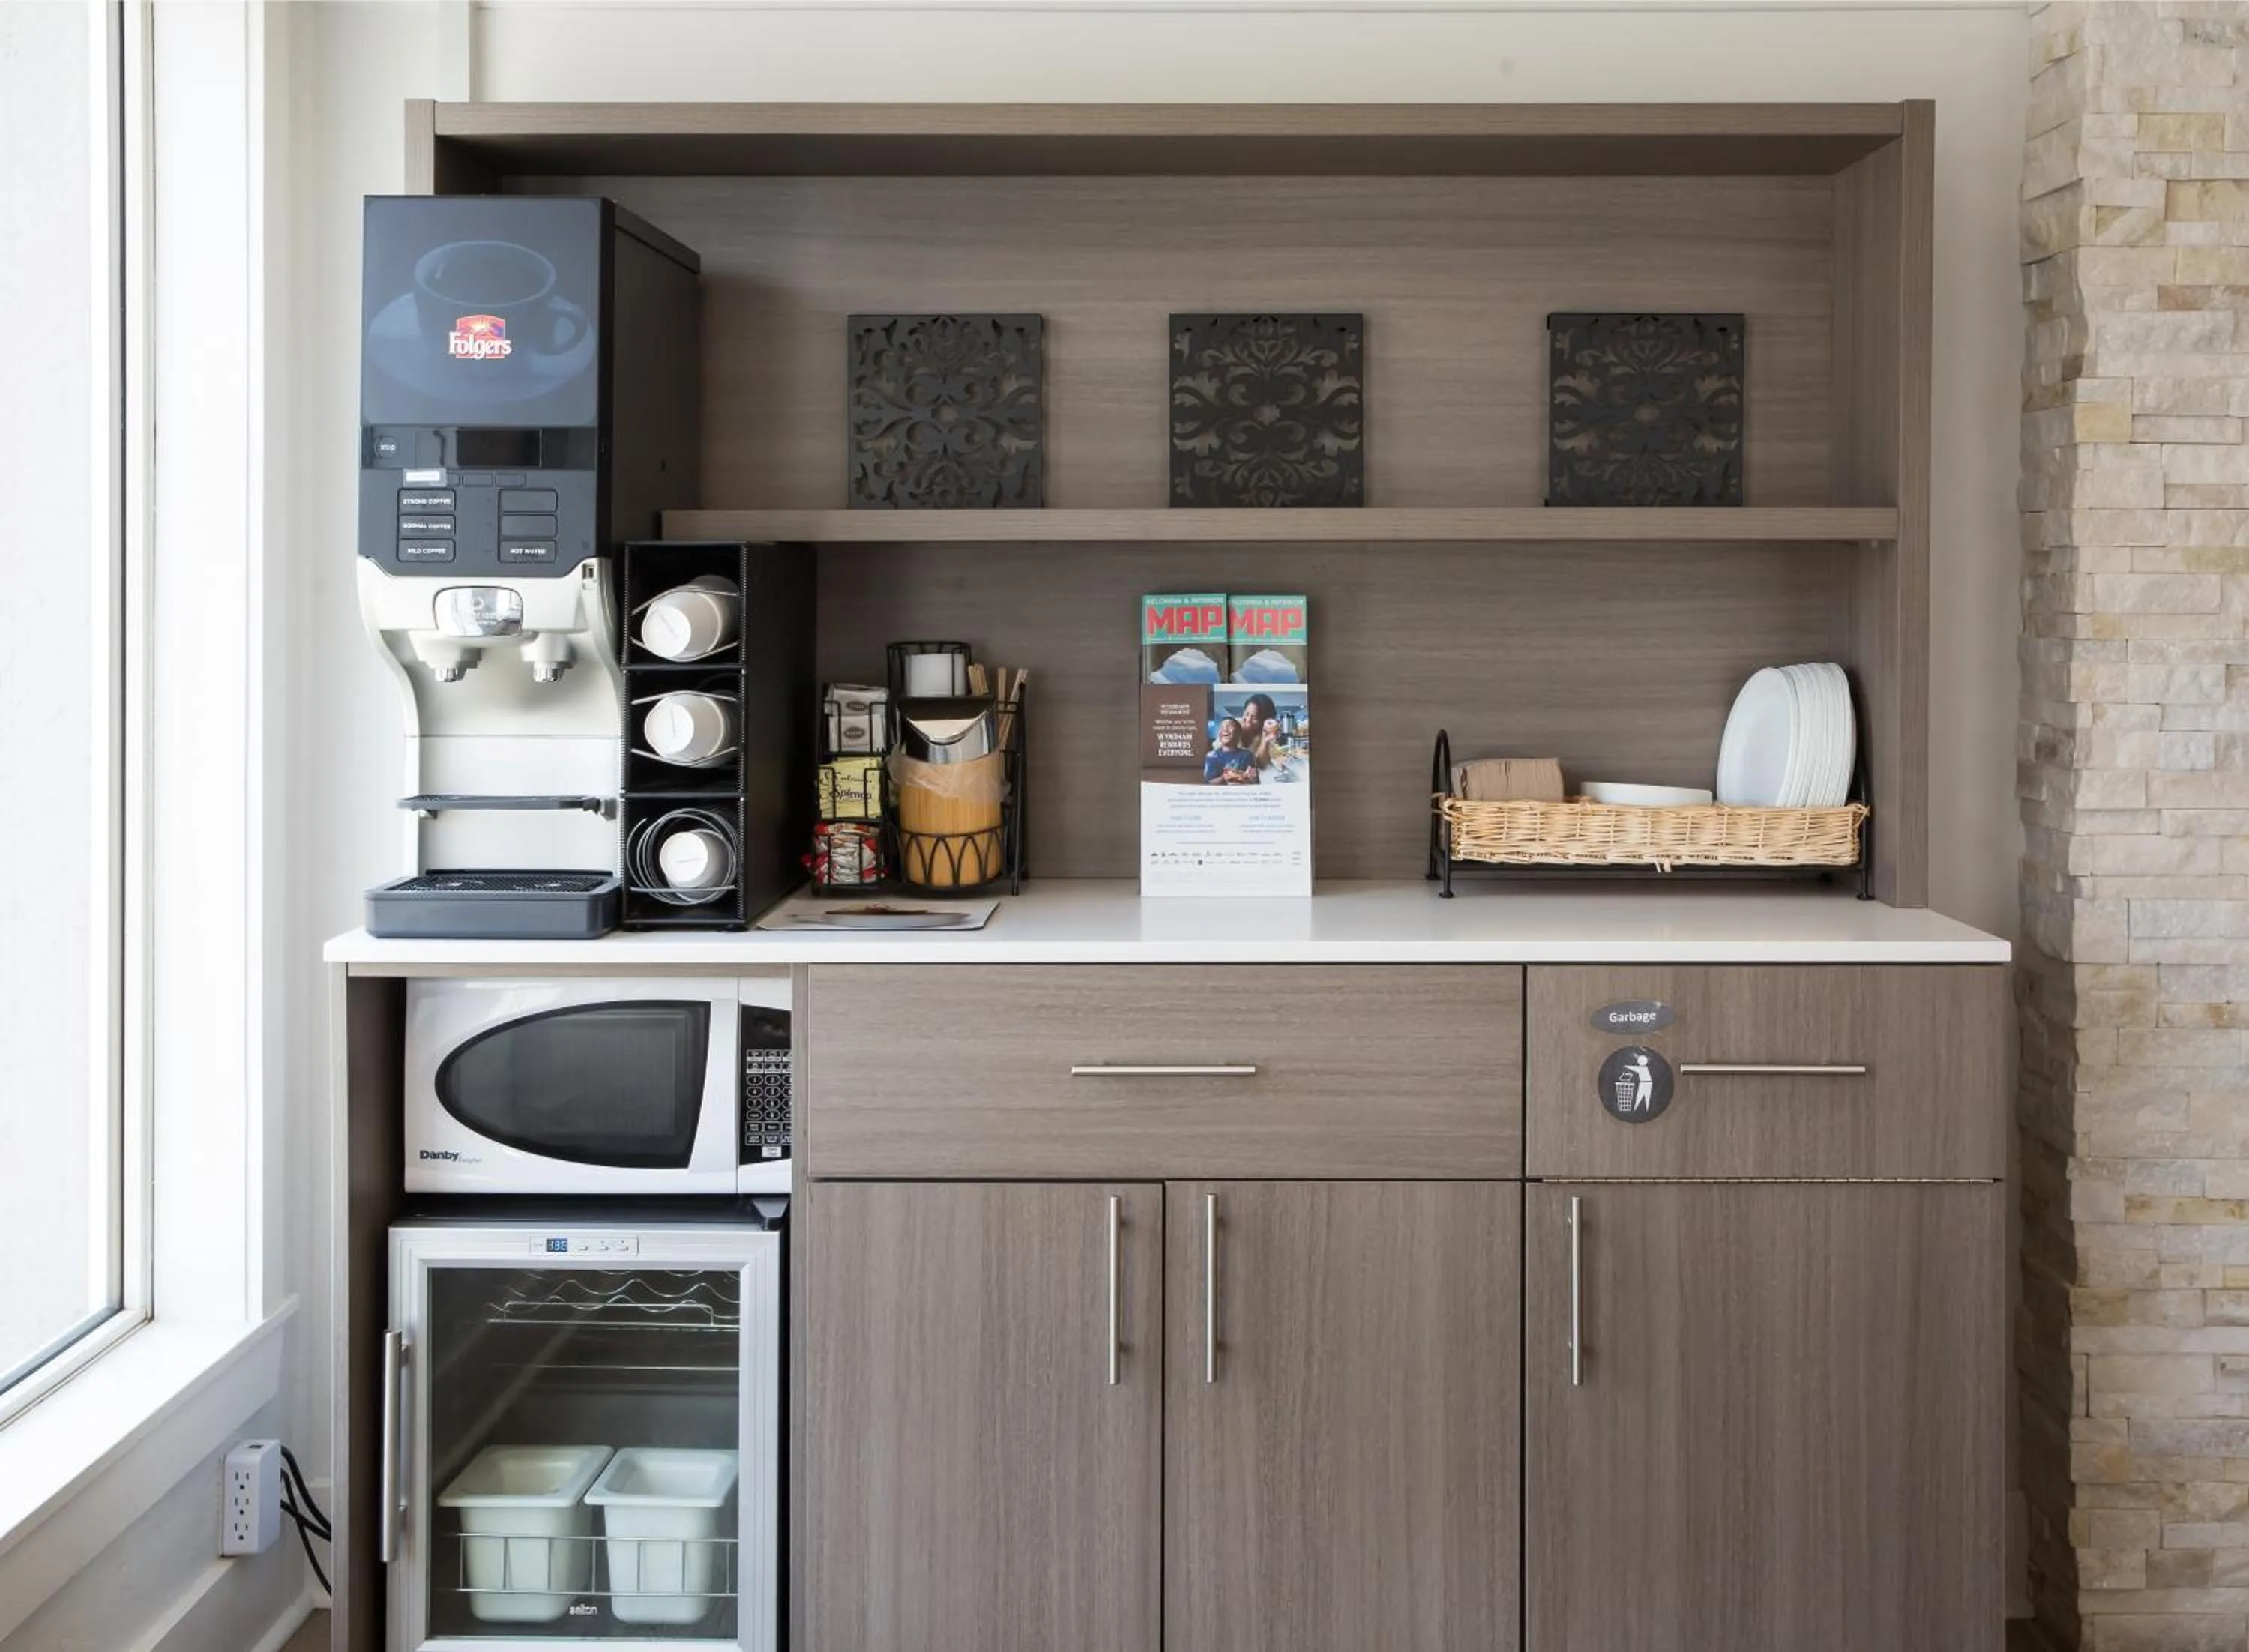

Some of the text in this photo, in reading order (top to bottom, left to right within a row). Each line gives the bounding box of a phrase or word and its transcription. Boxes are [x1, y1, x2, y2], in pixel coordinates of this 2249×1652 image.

[449, 331, 512, 359] Folgers
[1145, 606, 1223, 636] MAP
[1229, 608, 1303, 636] MAP
[1609, 1011, 1656, 1022] Garbage
[420, 1150, 459, 1162] Danby
